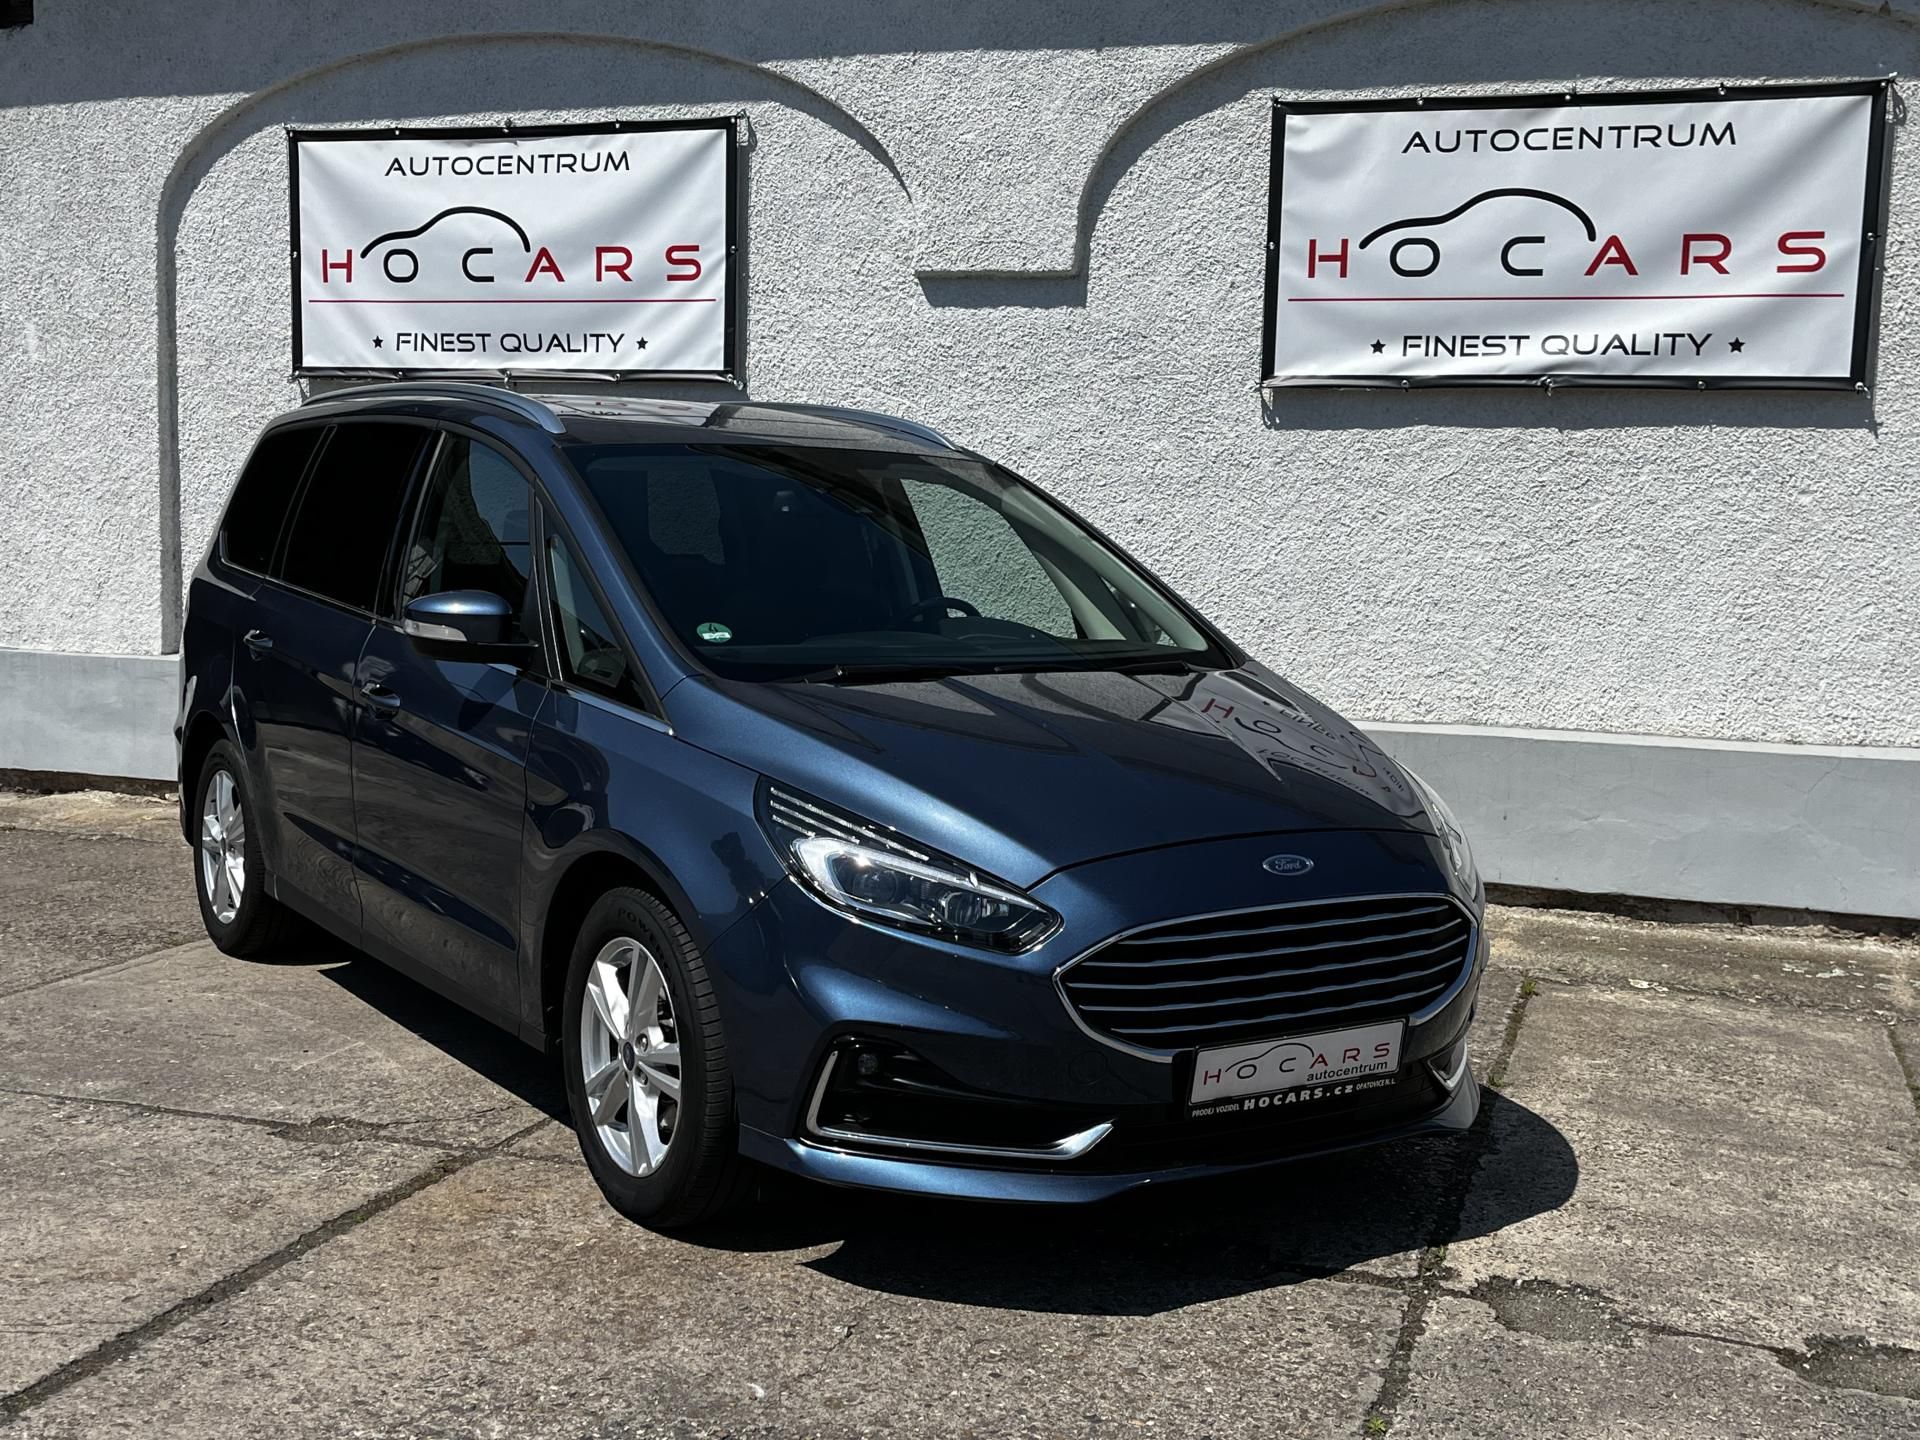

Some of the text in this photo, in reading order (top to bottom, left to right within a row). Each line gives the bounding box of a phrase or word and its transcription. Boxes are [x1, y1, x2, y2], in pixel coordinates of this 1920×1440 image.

[1402, 121, 1736, 154] AUTOCENTRUM
[385, 150, 630, 176] AUTOCENTRUM
[396, 332, 625, 353] FINEST QUALITY
[1402, 332, 1713, 358] FINEST QUALITY
[1306, 1061, 1388, 1082] autocentrum
[1216, 1103, 1240, 1113] VOZIDEL
